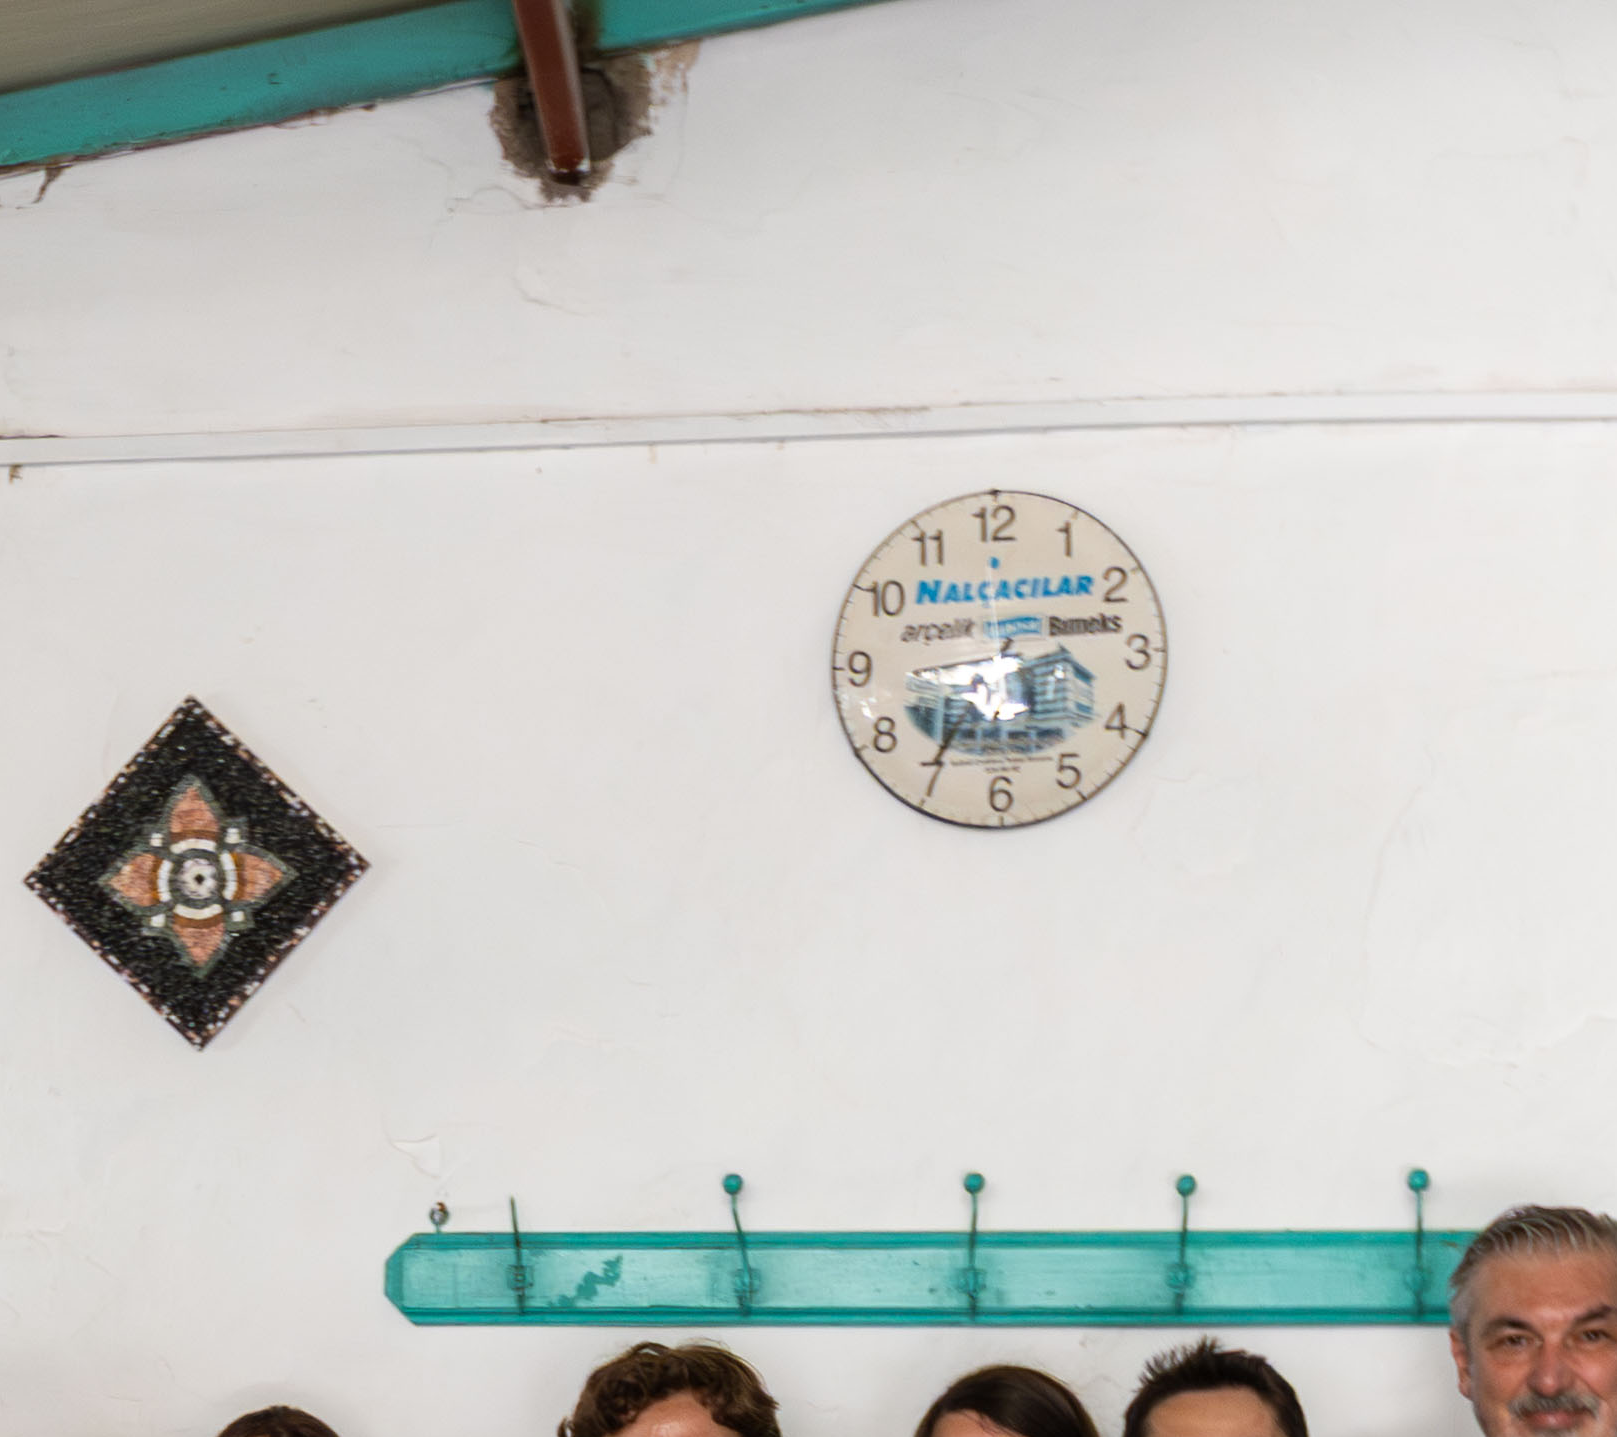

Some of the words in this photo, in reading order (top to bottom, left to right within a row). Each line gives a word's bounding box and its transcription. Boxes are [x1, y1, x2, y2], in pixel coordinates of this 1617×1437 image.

[972, 505, 1016, 542] 12
[1057, 521, 1073, 557] 1
[912, 530, 944, 566] 11
[868, 580, 905, 617] 10
[1101, 566, 1128, 602] 2
[848, 651, 873, 687] 9
[1124, 634, 1151, 670] 3
[873, 717, 898, 753] 8
[1104, 703, 1128, 739] 4
[920, 760, 944, 797] 7
[1056, 753, 1082, 789] 5
[989, 776, 1014, 812] 6
